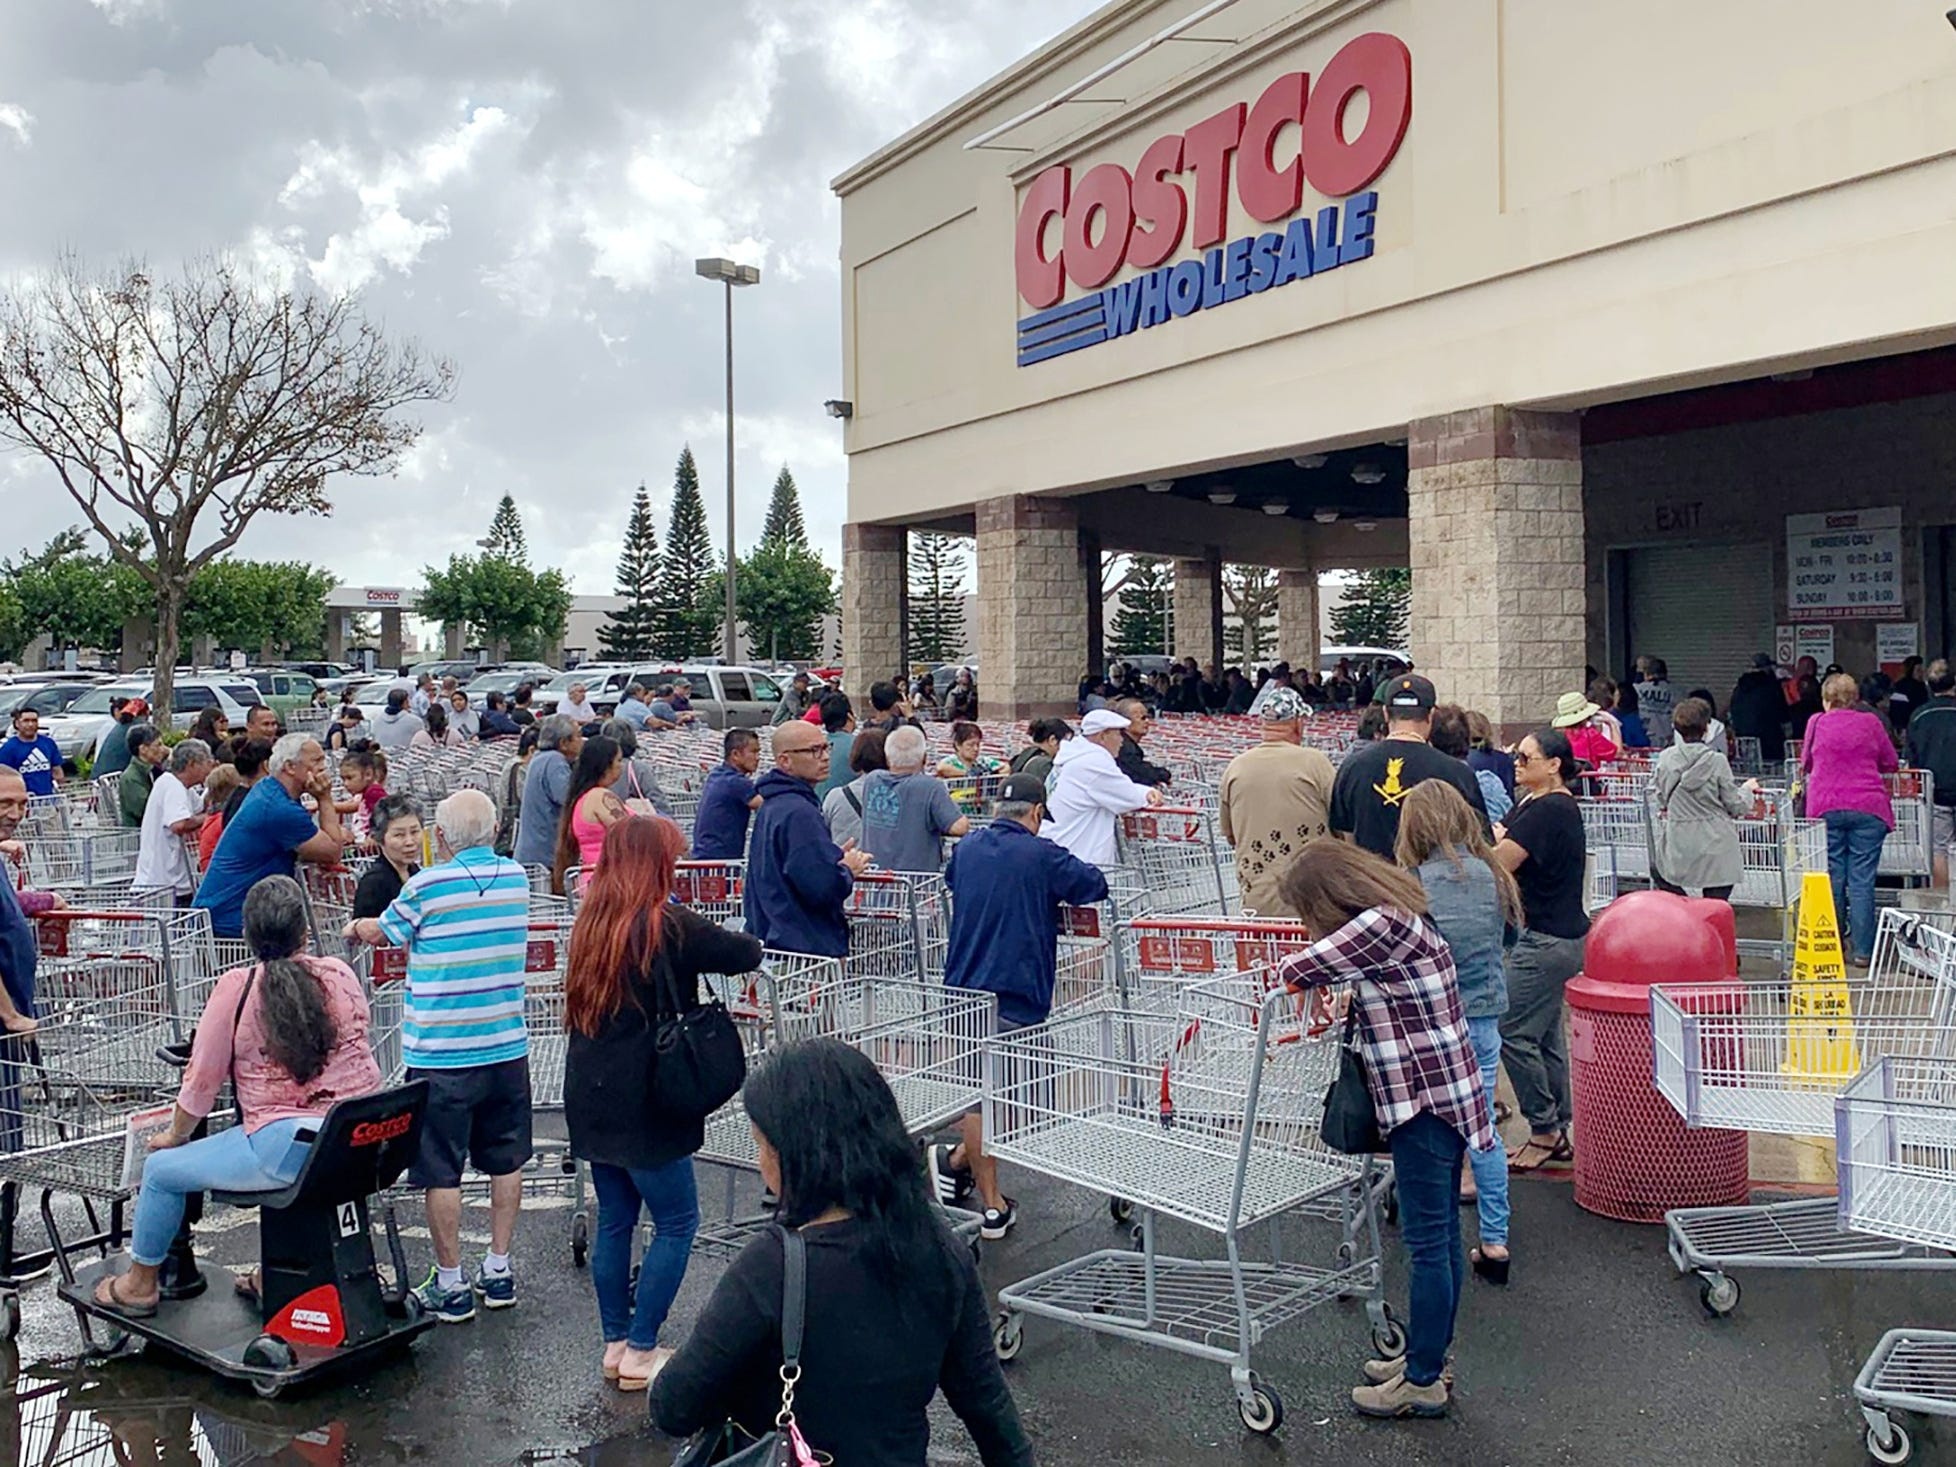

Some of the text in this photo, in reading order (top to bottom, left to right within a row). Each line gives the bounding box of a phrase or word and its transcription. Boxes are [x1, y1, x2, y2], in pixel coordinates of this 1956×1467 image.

[1015, 32, 1412, 309] COSTCO
[1101, 191, 1378, 340] WHOLESALE
[1656, 501, 1703, 532] EXIT
[1811, 534, 1875, 548] MEMBERS ONLY
[1819, 555, 1833, 566] FRI
[1796, 573, 1837, 586] SATURDAY
[367, 590, 399, 600] COSTCO
[1796, 592, 1827, 604] SUNDAY
[19, 763, 51, 774] adidas
[1813, 930, 1836, 939] CAUTION
[1813, 963, 1840, 974] SAFETY
[352, 1112, 412, 1139] COSTCO
[342, 1205, 356, 1231] 4
